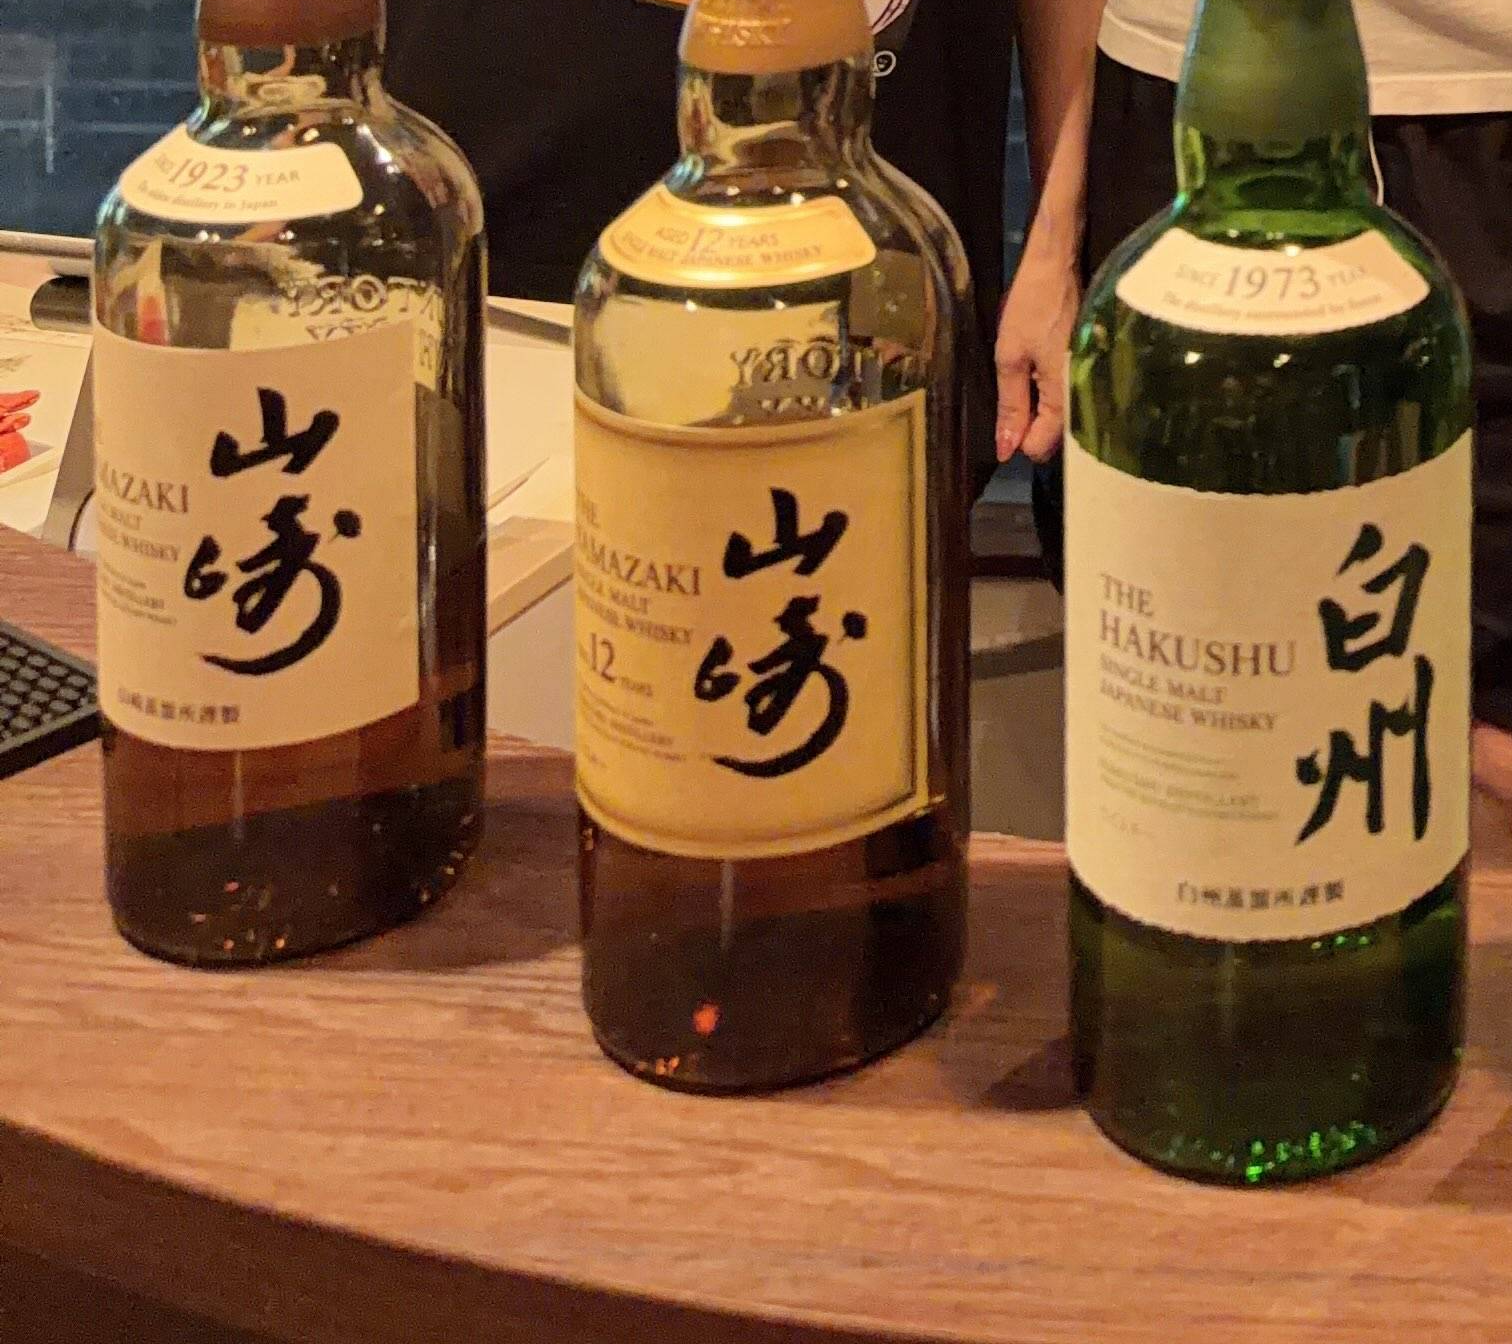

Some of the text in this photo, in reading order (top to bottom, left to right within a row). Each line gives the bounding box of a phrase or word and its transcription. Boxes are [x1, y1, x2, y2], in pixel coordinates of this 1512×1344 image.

[169, 159, 249, 193] 1923
[256, 169, 301, 186] YEAR
[690, 226, 723, 254] 12
[1225, 265, 1321, 301] 1973
[184, 387, 362, 677] 山崎
[1100, 573, 1154, 617] THE
[625, 614, 693, 646] WHISKY
[694, 487, 868, 778] 山崎
[1100, 608, 1297, 677] HAKUSHU
[590, 632, 618, 684] 12
[1100, 652, 1228, 705] SINGLE MALT
[1295, 522, 1434, 846] 白州
[1100, 679, 1279, 732] JAPANESE WHISKY
